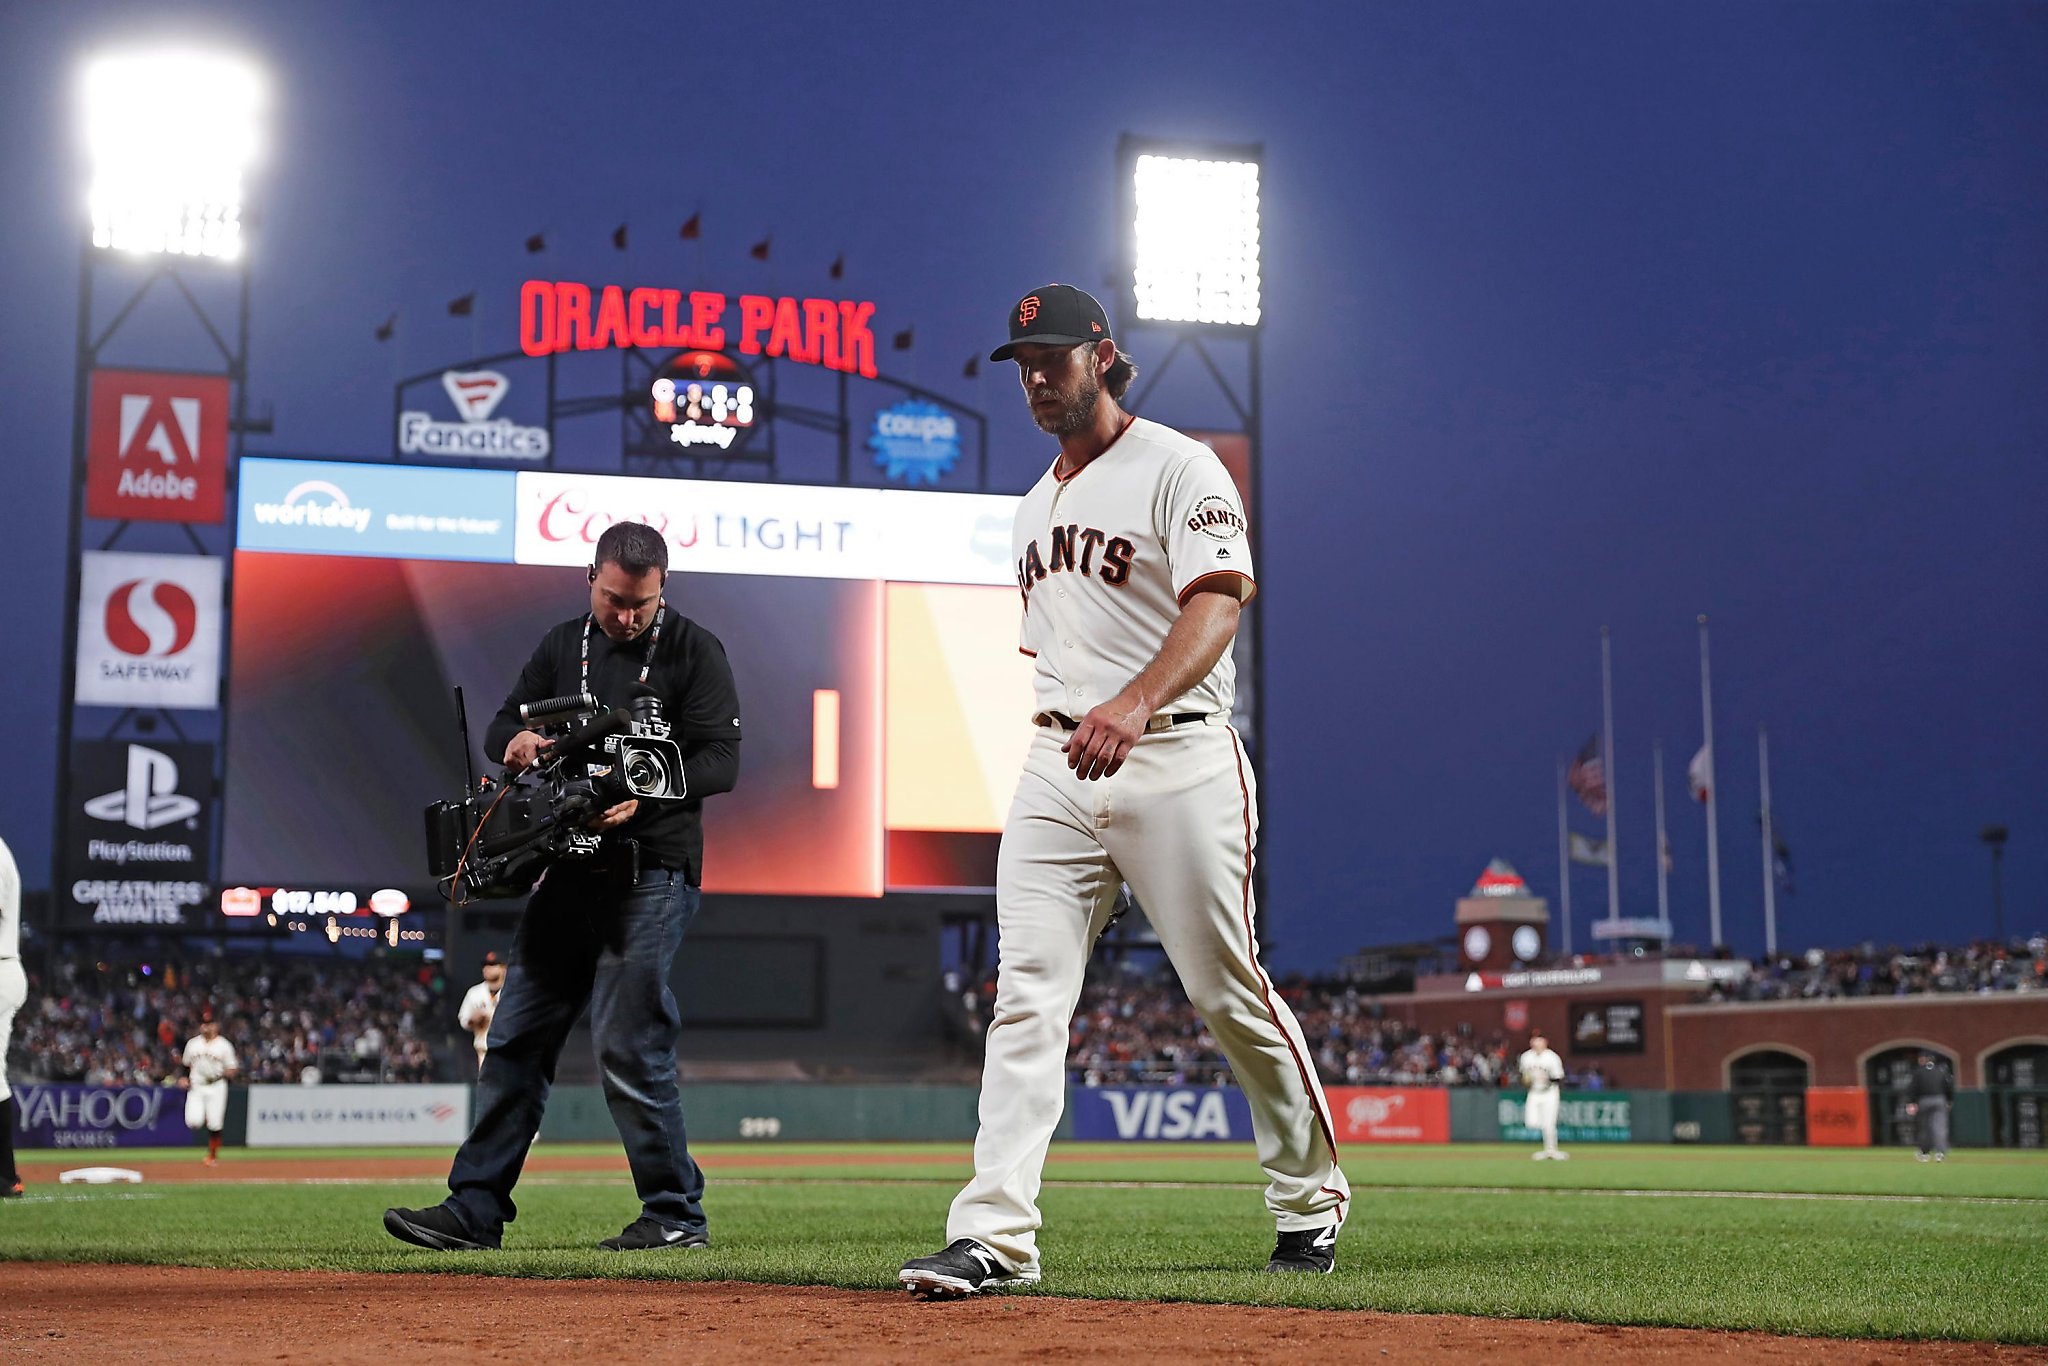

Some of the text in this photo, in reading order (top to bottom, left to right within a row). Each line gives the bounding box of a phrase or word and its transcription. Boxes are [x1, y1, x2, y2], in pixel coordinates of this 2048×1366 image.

[520, 280, 878, 379] ORACLE PARK
[400, 411, 551, 460] Fanatics
[117, 468, 197, 500] Adobe
[254, 499, 371, 534] workday
[1187, 510, 1244, 532] GIANTS
[715, 513, 853, 555] LIGHT
[101, 659, 193, 683] SAFEWAY
[88, 839, 192, 865] PlayStation
[72, 880, 202, 905] GREATNESS
[13, 1086, 164, 1132] YAHOO!
[258, 1108, 417, 1124] BANK OF AMERICA
[1101, 1091, 1230, 1140] VISA
[53, 1130, 116, 1148] SPORTS
